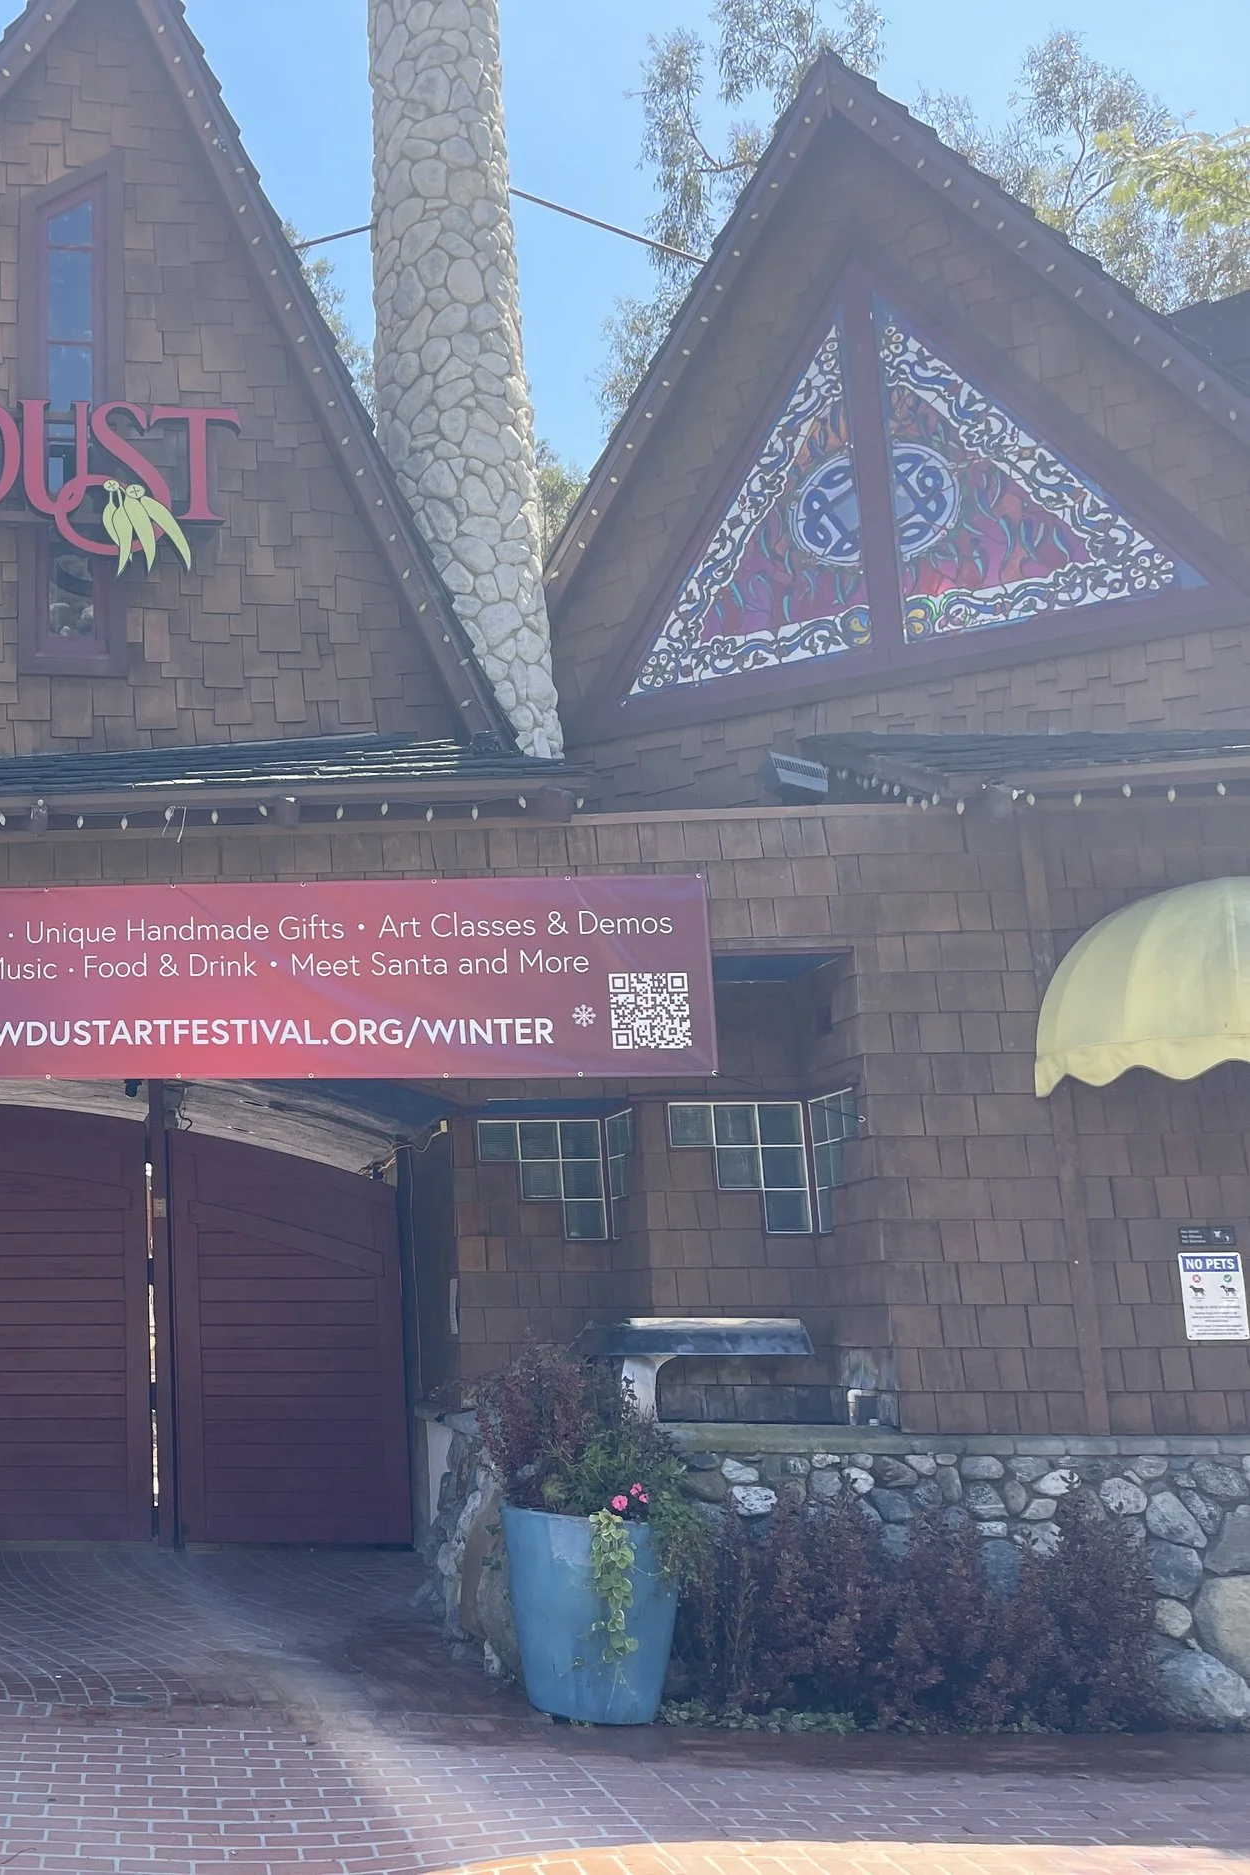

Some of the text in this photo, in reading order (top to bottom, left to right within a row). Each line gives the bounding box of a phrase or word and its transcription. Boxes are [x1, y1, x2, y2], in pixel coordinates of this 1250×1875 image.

[25, 920, 117, 950] Unique
[126, 915, 270, 942] Handmade
[278, 914, 345, 941] Gifts
[378, 914, 422, 939] Art
[430, 911, 537, 938] Classes
[547, 910, 570, 937] &
[578, 909, 674, 936] Demos
[84, 952, 147, 979] Food
[158, 953, 180, 978] &
[189, 951, 258, 978] Drink
[291, 953, 361, 977] Meet
[371, 951, 448, 977] Santa
[458, 948, 508, 975] and
[519, 948, 590, 974] More
[1185, 1258, 1236, 1271] NO PETS
